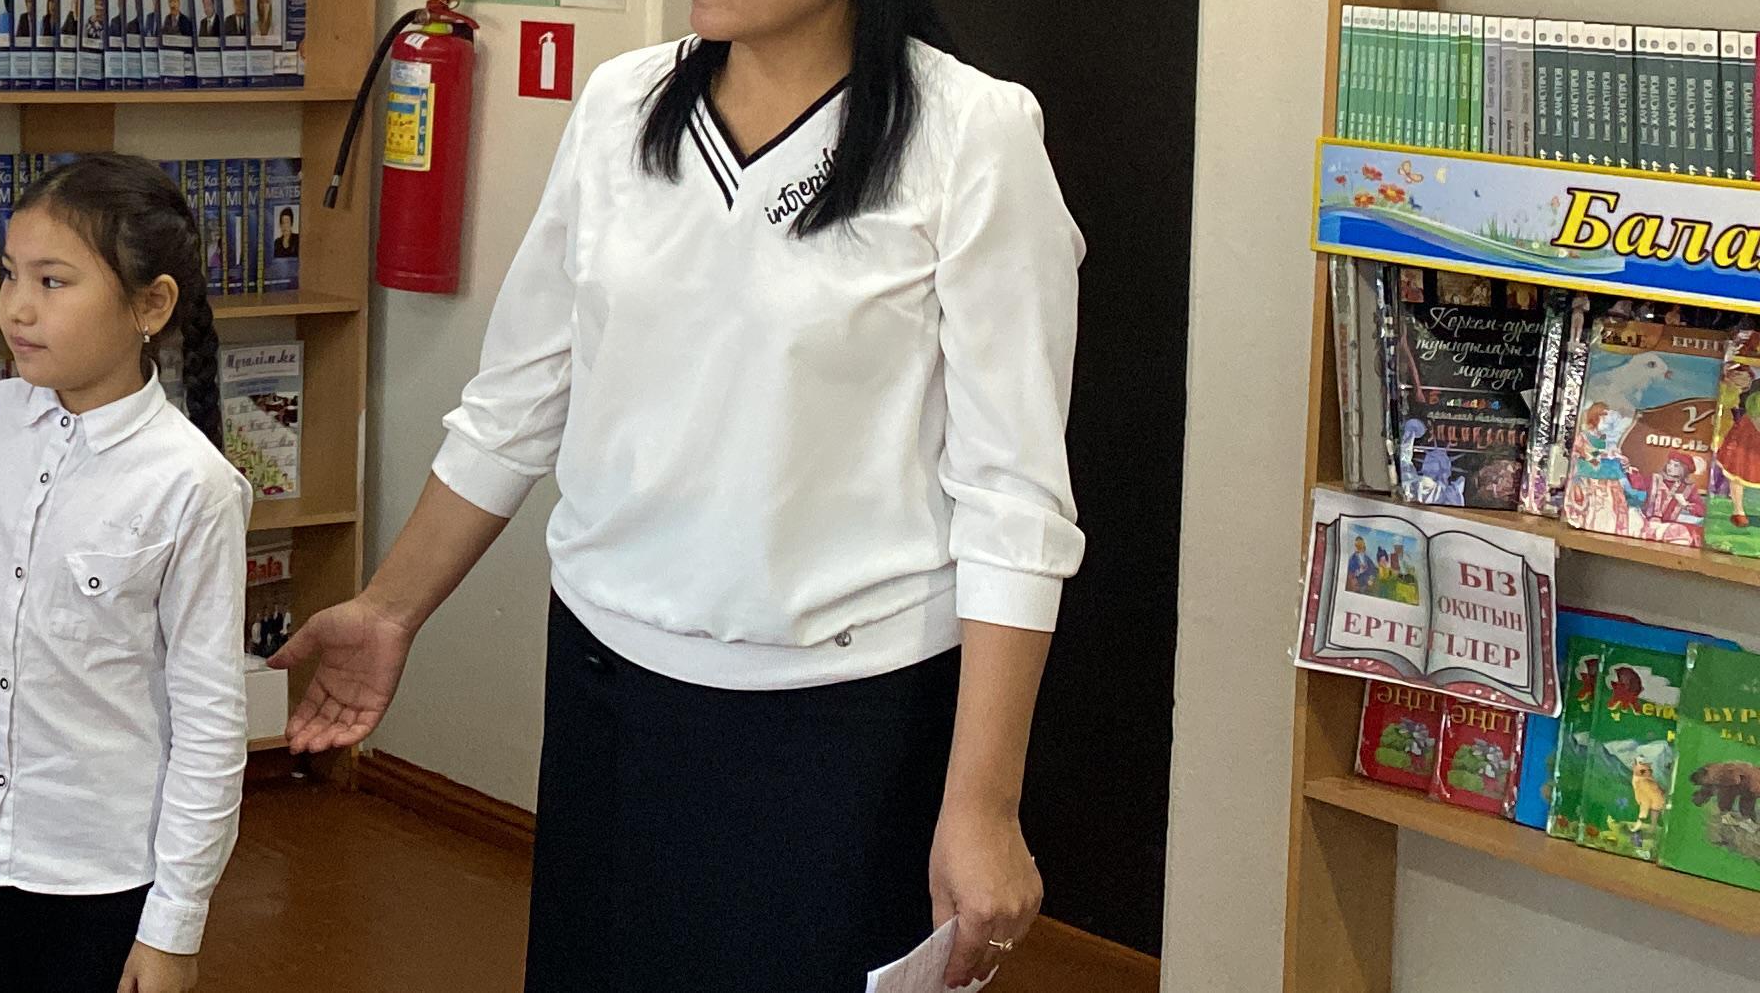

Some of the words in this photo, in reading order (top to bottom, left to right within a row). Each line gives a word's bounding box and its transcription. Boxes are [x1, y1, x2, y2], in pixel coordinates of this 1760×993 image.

[1551, 187, 1760, 271] Бала
[1646, 434, 1709, 452] апель
[1458, 562, 1517, 597] БІЗ
[1439, 595, 1523, 632] ОҚИТЫН
[1344, 612, 1521, 669] ЕРТЕГІЛЕР
